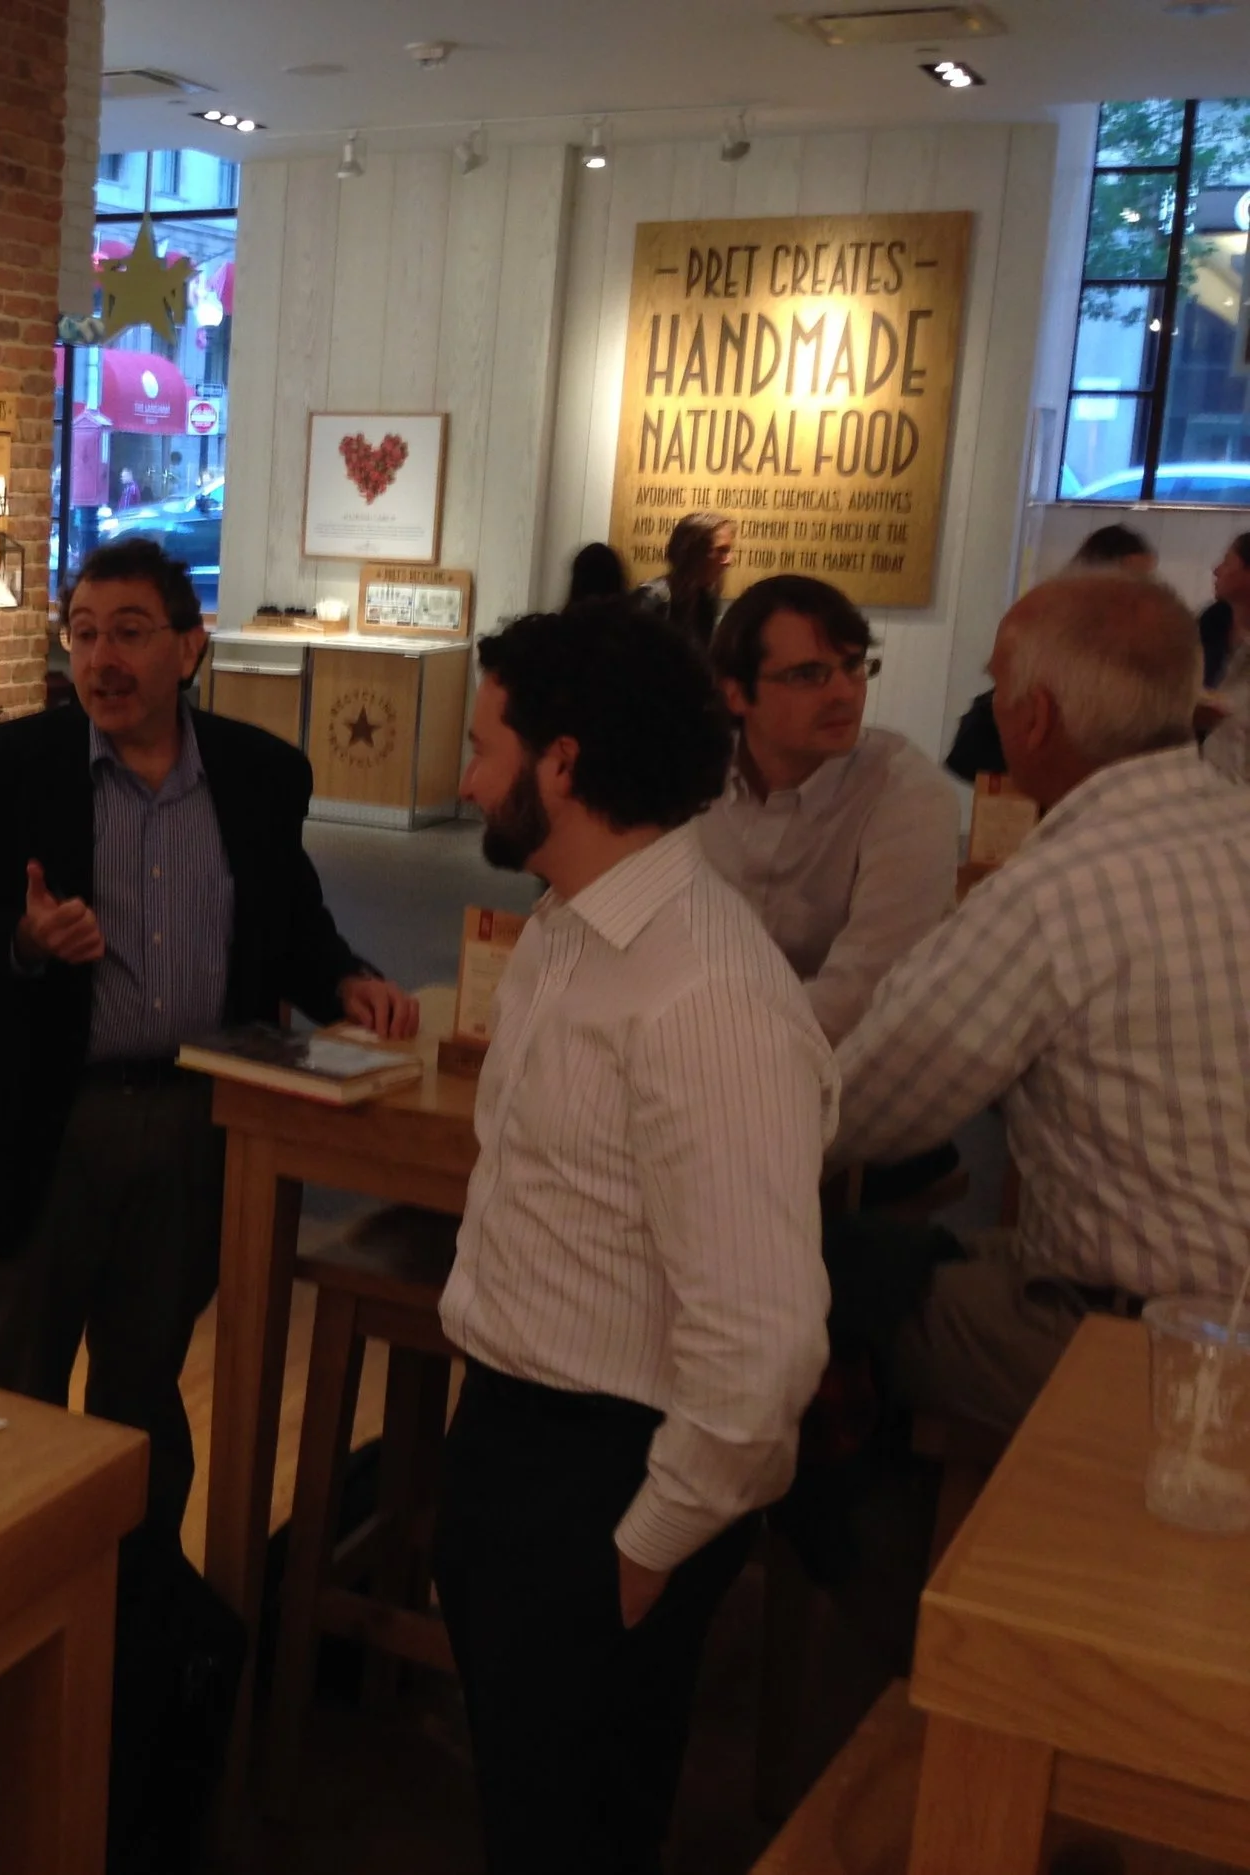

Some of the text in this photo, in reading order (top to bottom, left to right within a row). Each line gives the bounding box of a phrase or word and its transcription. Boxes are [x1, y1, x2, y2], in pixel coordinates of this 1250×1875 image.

[685, 240, 907, 298] PRET CREATES
[645, 310, 933, 397] HANDMADE
[638, 409, 919, 478] NATURAL FOOD
[636, 487, 686, 510] AVOIDING
[692, 488, 712, 510] THE
[716, 488, 768, 511] OBSCURE
[849, 490, 912, 514] ADDITIVES
[633, 516, 654, 537] AND
[740, 520, 789, 542] COMMON
[794, 520, 807, 542] TO
[811, 521, 826, 542] SO
[830, 521, 862, 543] MUCH
[867, 522, 881, 543] OF
[887, 523, 909, 544] THE
[748, 549, 776, 570] FOOD
[780, 550, 795, 570] ON
[800, 550, 818, 570] THE
[823, 551, 866, 573] MARKET
[871, 553, 905, 574] TODAY
